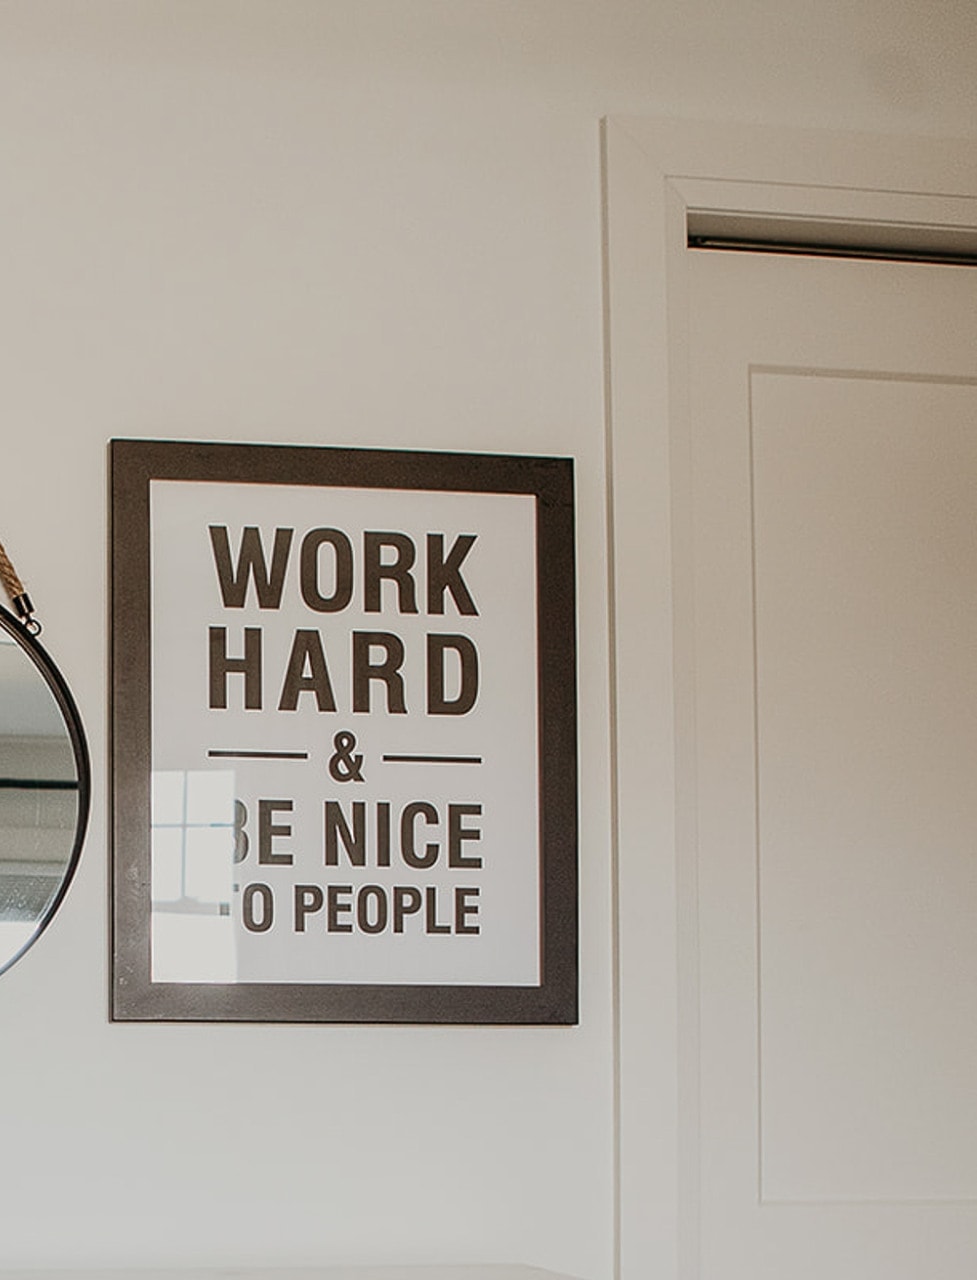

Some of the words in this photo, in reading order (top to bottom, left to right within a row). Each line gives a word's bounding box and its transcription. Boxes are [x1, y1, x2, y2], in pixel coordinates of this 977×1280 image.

[208, 525, 479, 616] WORK
[209, 627, 479, 715] HARD
[328, 731, 365, 783] &
[325, 802, 483, 868] NICE
[235, 883, 274, 933] O
[294, 885, 480, 935] PEOPLE
